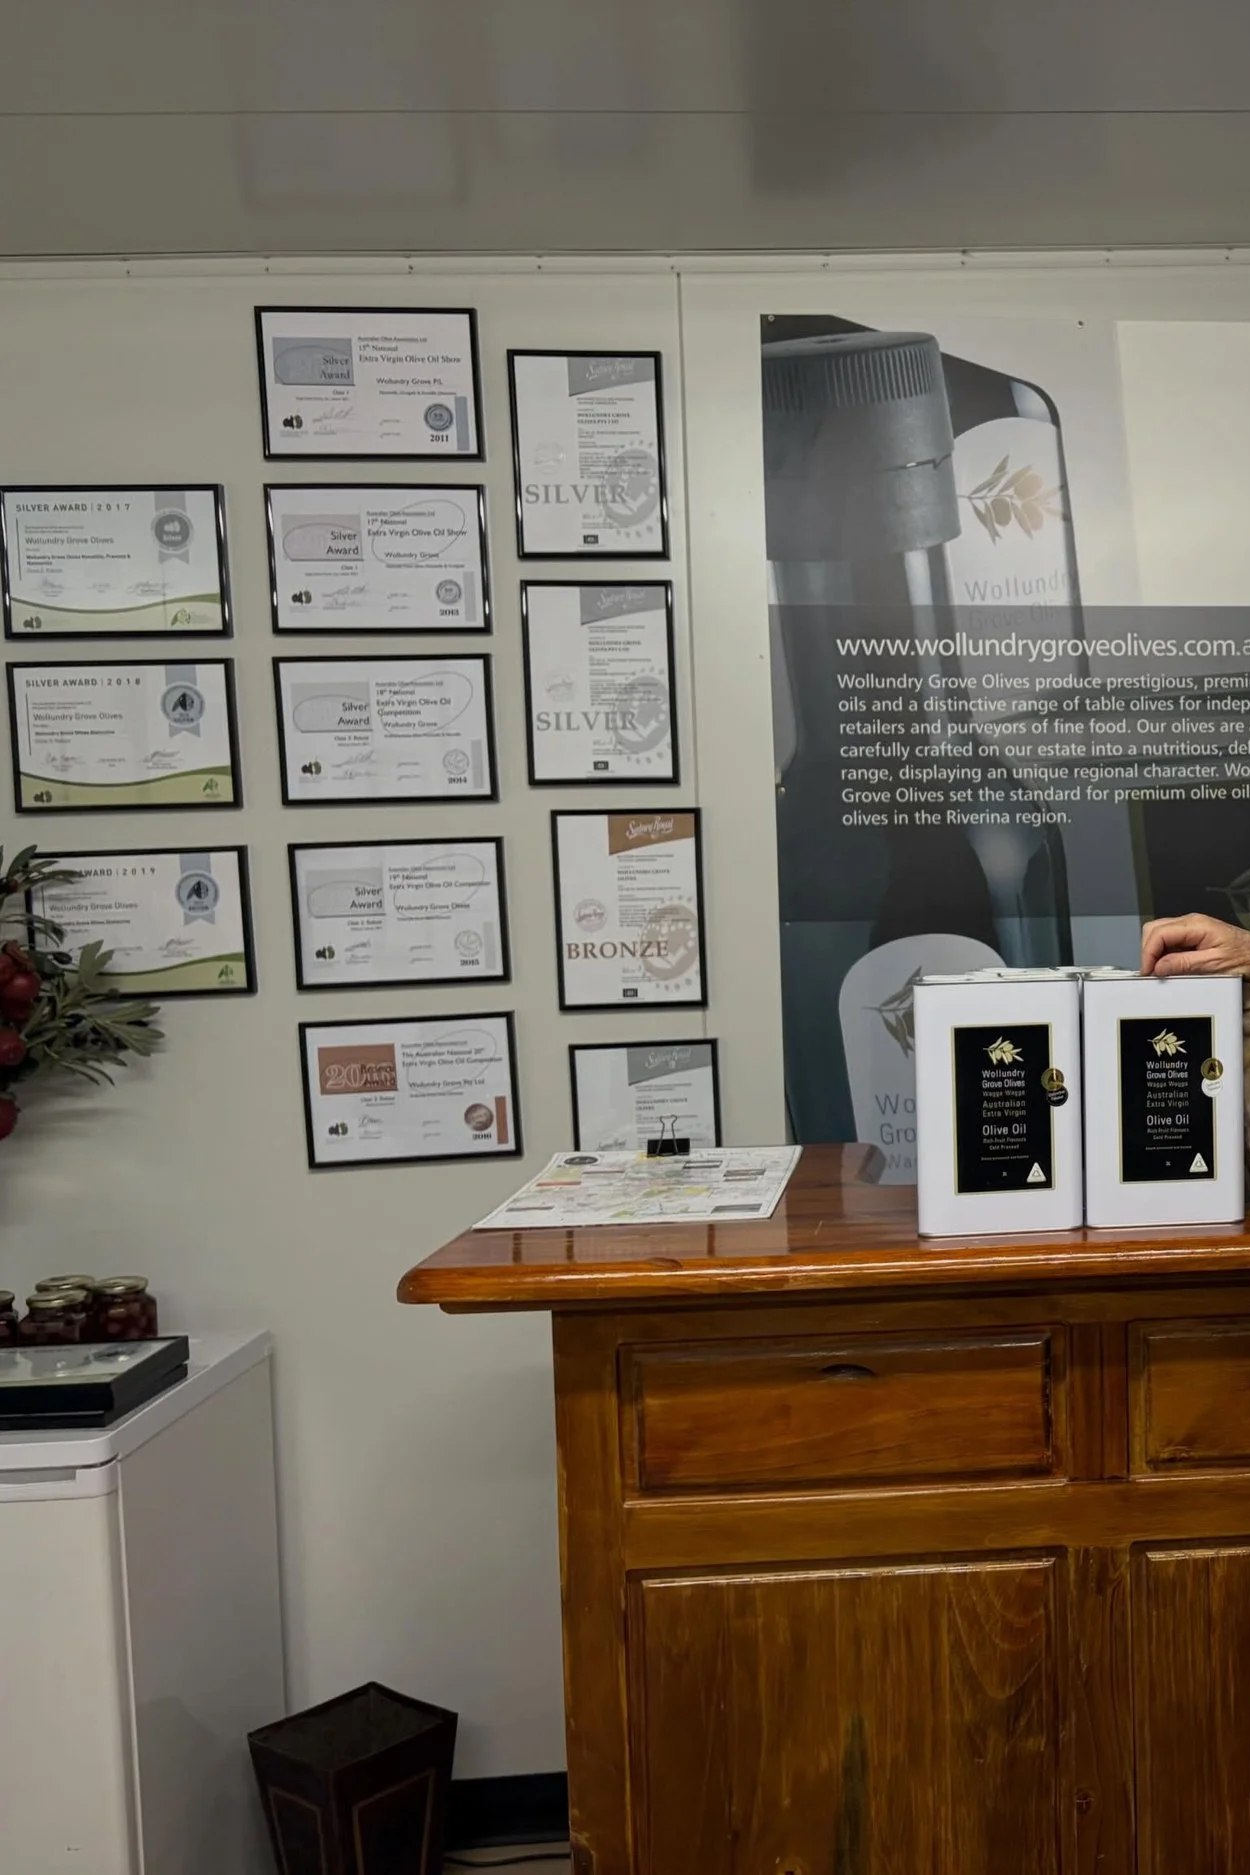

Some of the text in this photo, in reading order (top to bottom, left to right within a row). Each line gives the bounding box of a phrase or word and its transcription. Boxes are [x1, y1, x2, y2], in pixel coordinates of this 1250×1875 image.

[322, 356, 349, 365] Silver
[405, 355, 425, 363] Olive
[320, 370, 350, 379] Award
[376, 378, 409, 386] Wollundry
[525, 484, 626, 504] SILVER
[16, 504, 49, 512] SILVER
[53, 504, 87, 512] AWARD
[331, 532, 357, 540] Silver
[368, 529, 387, 537] Extra
[389, 529, 410, 537] Virgin
[326, 546, 359, 555] Award
[25, 679, 59, 688] SILVER
[63, 679, 98, 687] AWARD
[837, 674, 923, 692] Wollundry
[929, 674, 977, 689] Grove
[982, 674, 1030, 689] Olives
[1035, 674, 1101, 692] produce
[1107, 673, 1198, 692] prestigious,
[419, 698, 438, 706] Olive
[839, 697, 866, 712] oils
[872, 697, 902, 711] and
[909, 700, 918, 711] a
[923, 696, 1006, 711] distinctive
[1012, 700, 1058, 715] range
[1063, 696, 1080, 711] of
[1085, 697, 1125, 711] table
[1130, 697, 1174, 711] olives
[1179, 696, 1202, 710] for
[342, 702, 369, 712] Silver
[338, 717, 370, 726] Award
[537, 711, 638, 731] SILVER
[840, 720, 905, 735] retailers
[910, 719, 941, 734] and
[947, 722, 1026, 738] purveyors
[1032, 719, 1048, 734] of
[1054, 718, 1084, 733] fine
[1090, 718, 1130, 733] food.
[1137, 719, 1166, 733] Our
[1171, 718, 1215, 733] olives
[1220, 721, 1244, 732] are
[840, 742, 910, 761] carefully
[915, 742, 972, 757] crafted
[978, 745, 999, 757] on
[1005, 744, 1032, 757] our
[1038, 743, 1086, 757] estate
[1091, 742, 1123, 756] into
[1128, 745, 1137, 755] a
[1143, 741, 1222, 757] nutritious,
[841, 768, 893, 783] range,
[899, 764, 981, 783] displaying
[987, 768, 1007, 780] an
[1013, 764, 1068, 782] unique
[1074, 764, 1138, 782] regional
[1143, 763, 1219, 778] character.
[842, 788, 890, 803] Grove
[896, 788, 944, 802] Olives
[950, 788, 973, 802] set
[978, 787, 1005, 801] the
[1010, 786, 1080, 801] standard
[1086, 786, 1109, 800] for
[1114, 787, 1185, 803] premium
[1191, 786, 1227, 799] olive
[1232, 785, 1250, 798] oil
[843, 809, 1071, 827] olives in the Riverina region.
[78, 869, 112, 877] AWARD
[355, 887, 382, 896] Silver
[350, 900, 383, 909] Award
[567, 940, 669, 959] BRONZE
[1146, 1061, 1188, 1069] Wollundry
[982, 1070, 1025, 1078] Wollundry
[1147, 1070, 1188, 1079] Grove Olives
[982, 1079, 1025, 1088] Grove Olives
[1147, 1091, 1188, 1099] Australian
[1168, 1100, 1189, 1108] Virgin
[1147, 1115, 1189, 1125] Olive Oil
[880, 1122, 917, 1145] Gro
[983, 1124, 1026, 1135] Olive Oil
